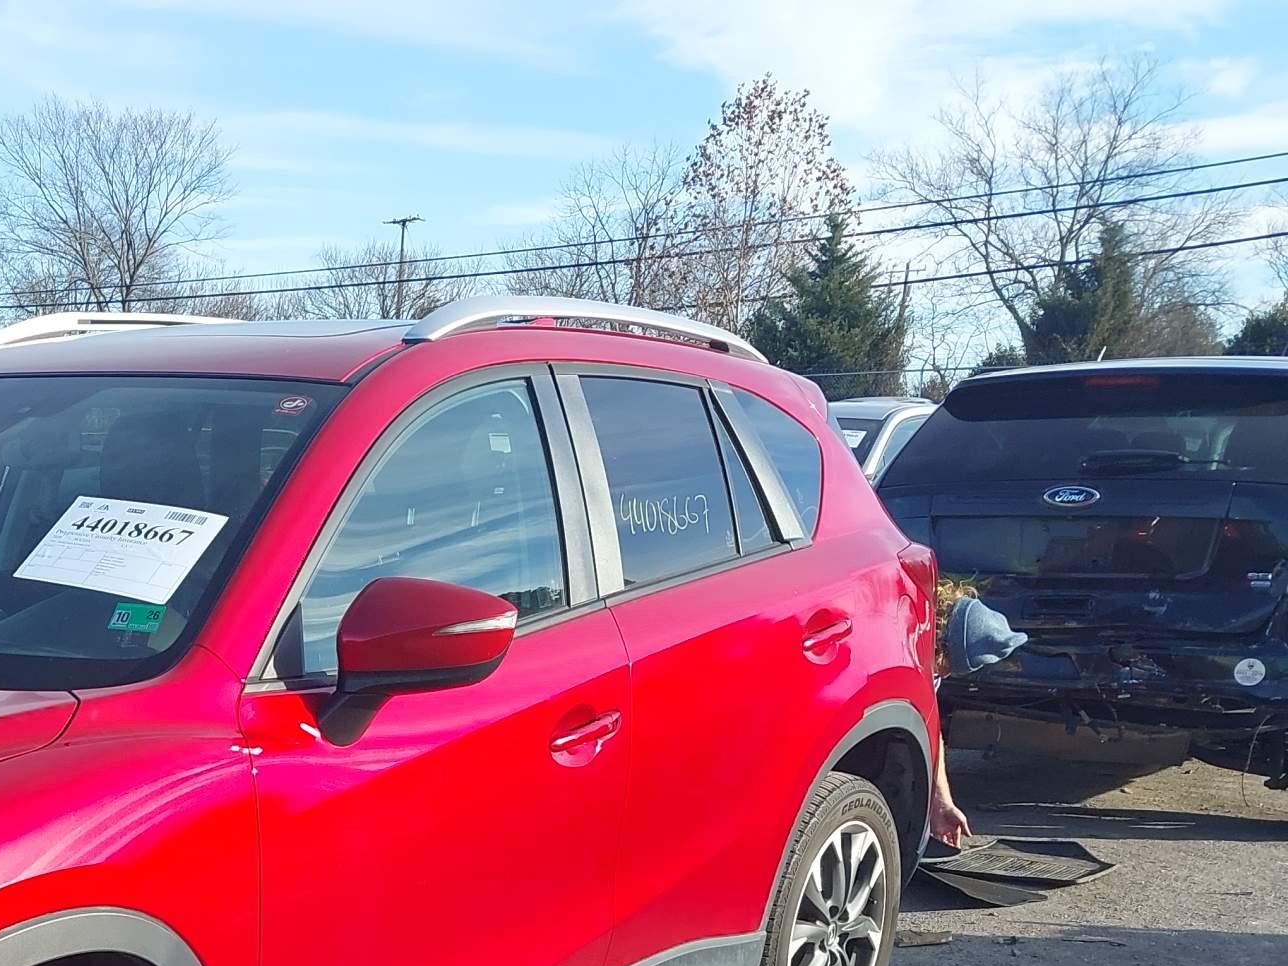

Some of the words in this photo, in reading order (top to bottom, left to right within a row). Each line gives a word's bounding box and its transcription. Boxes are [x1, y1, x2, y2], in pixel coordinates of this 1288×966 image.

[72, 515, 195, 546] 44018667
[619, 494, 711, 537] 44018667
[116, 611, 130, 623] 10
[147, 610, 161, 621] 26
[841, 797, 892, 831] GEOLANDAR
